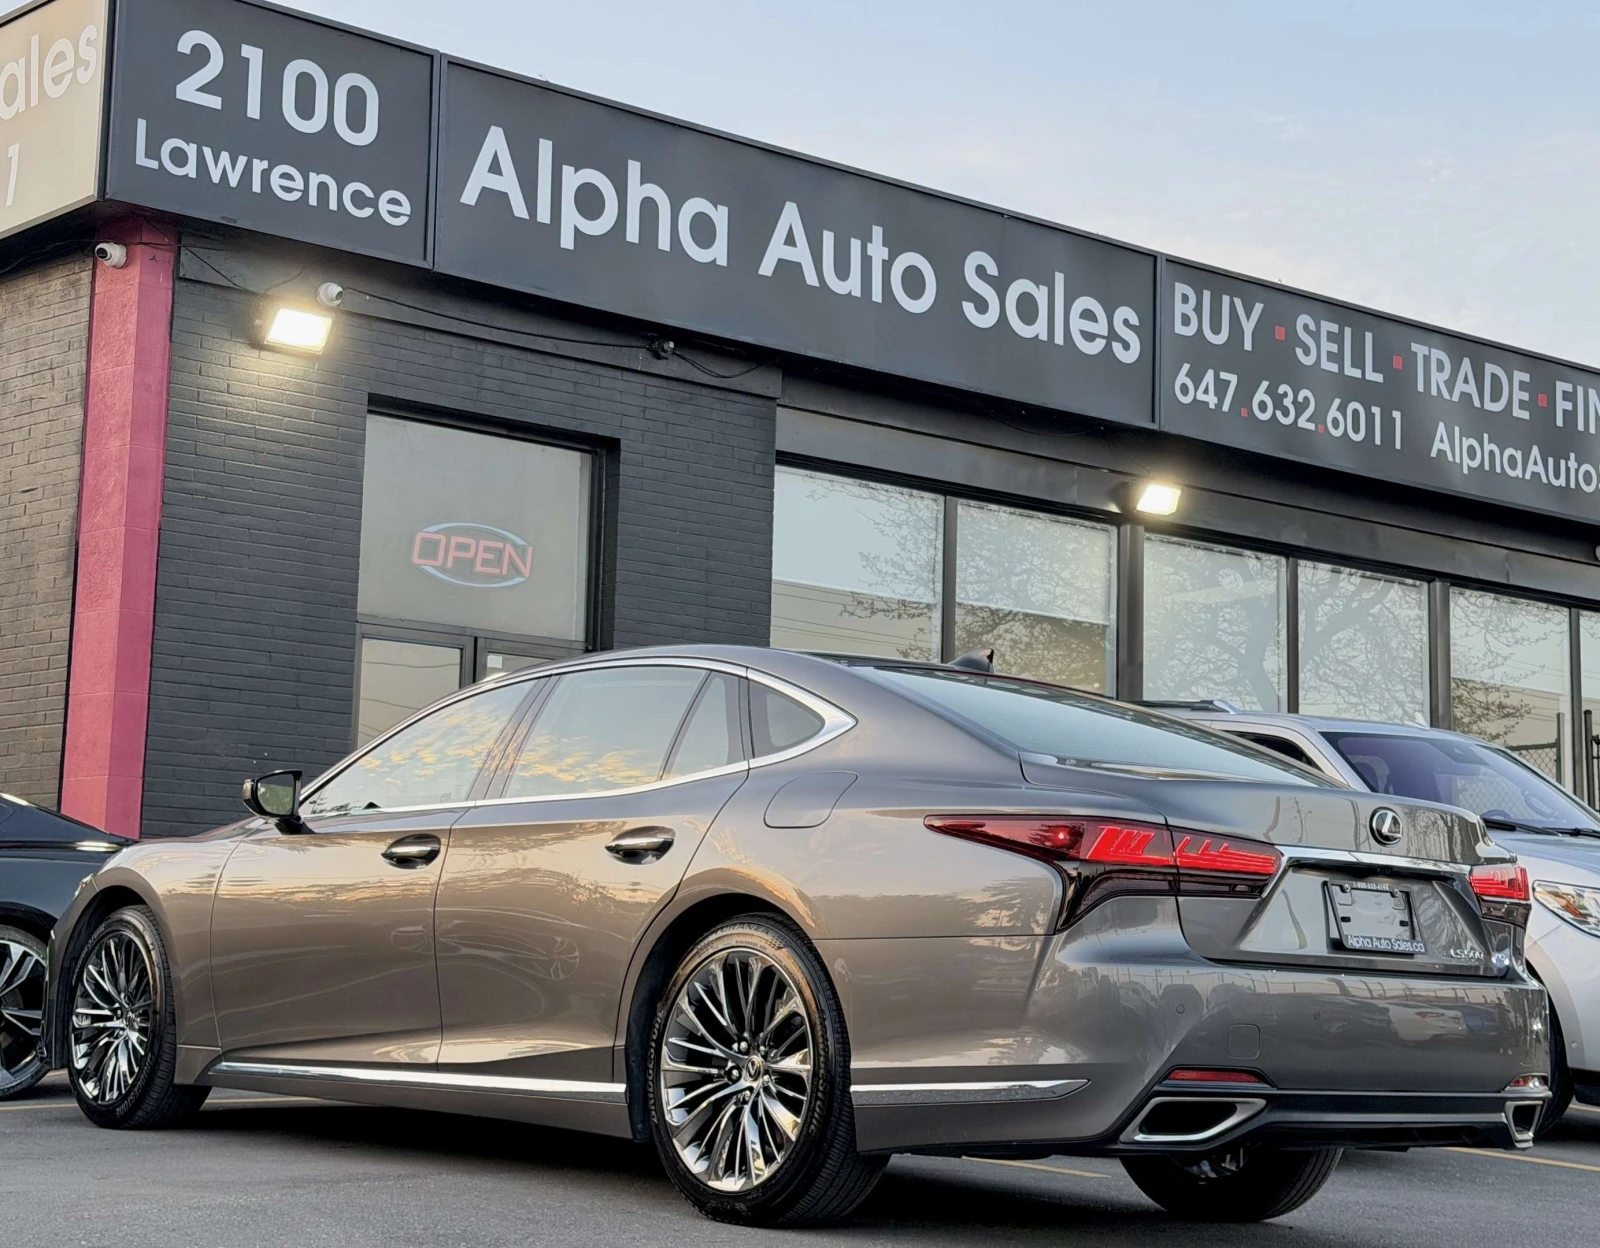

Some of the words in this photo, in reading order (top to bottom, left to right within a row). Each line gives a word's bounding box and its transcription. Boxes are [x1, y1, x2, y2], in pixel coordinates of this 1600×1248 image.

[175, 29, 380, 146] 2100
[135, 117, 412, 227] Lawrence
[460, 125, 729, 267] Alpha
[757, 201, 937, 314] Auto
[962, 250, 1141, 364] Sales
[1174, 281, 1265, 352] BUY
[1294, 313, 1384, 383] SELL
[1410, 342, 1531, 421] TRADE
[1174, 362, 1402, 450] 647.632.6011
[1430, 420, 1600, 493] AlphaAuto
[412, 532, 535, 578] OPEN
[1347, 935, 1372, 949] Alpha
[1372, 936, 1392, 950] Auto
